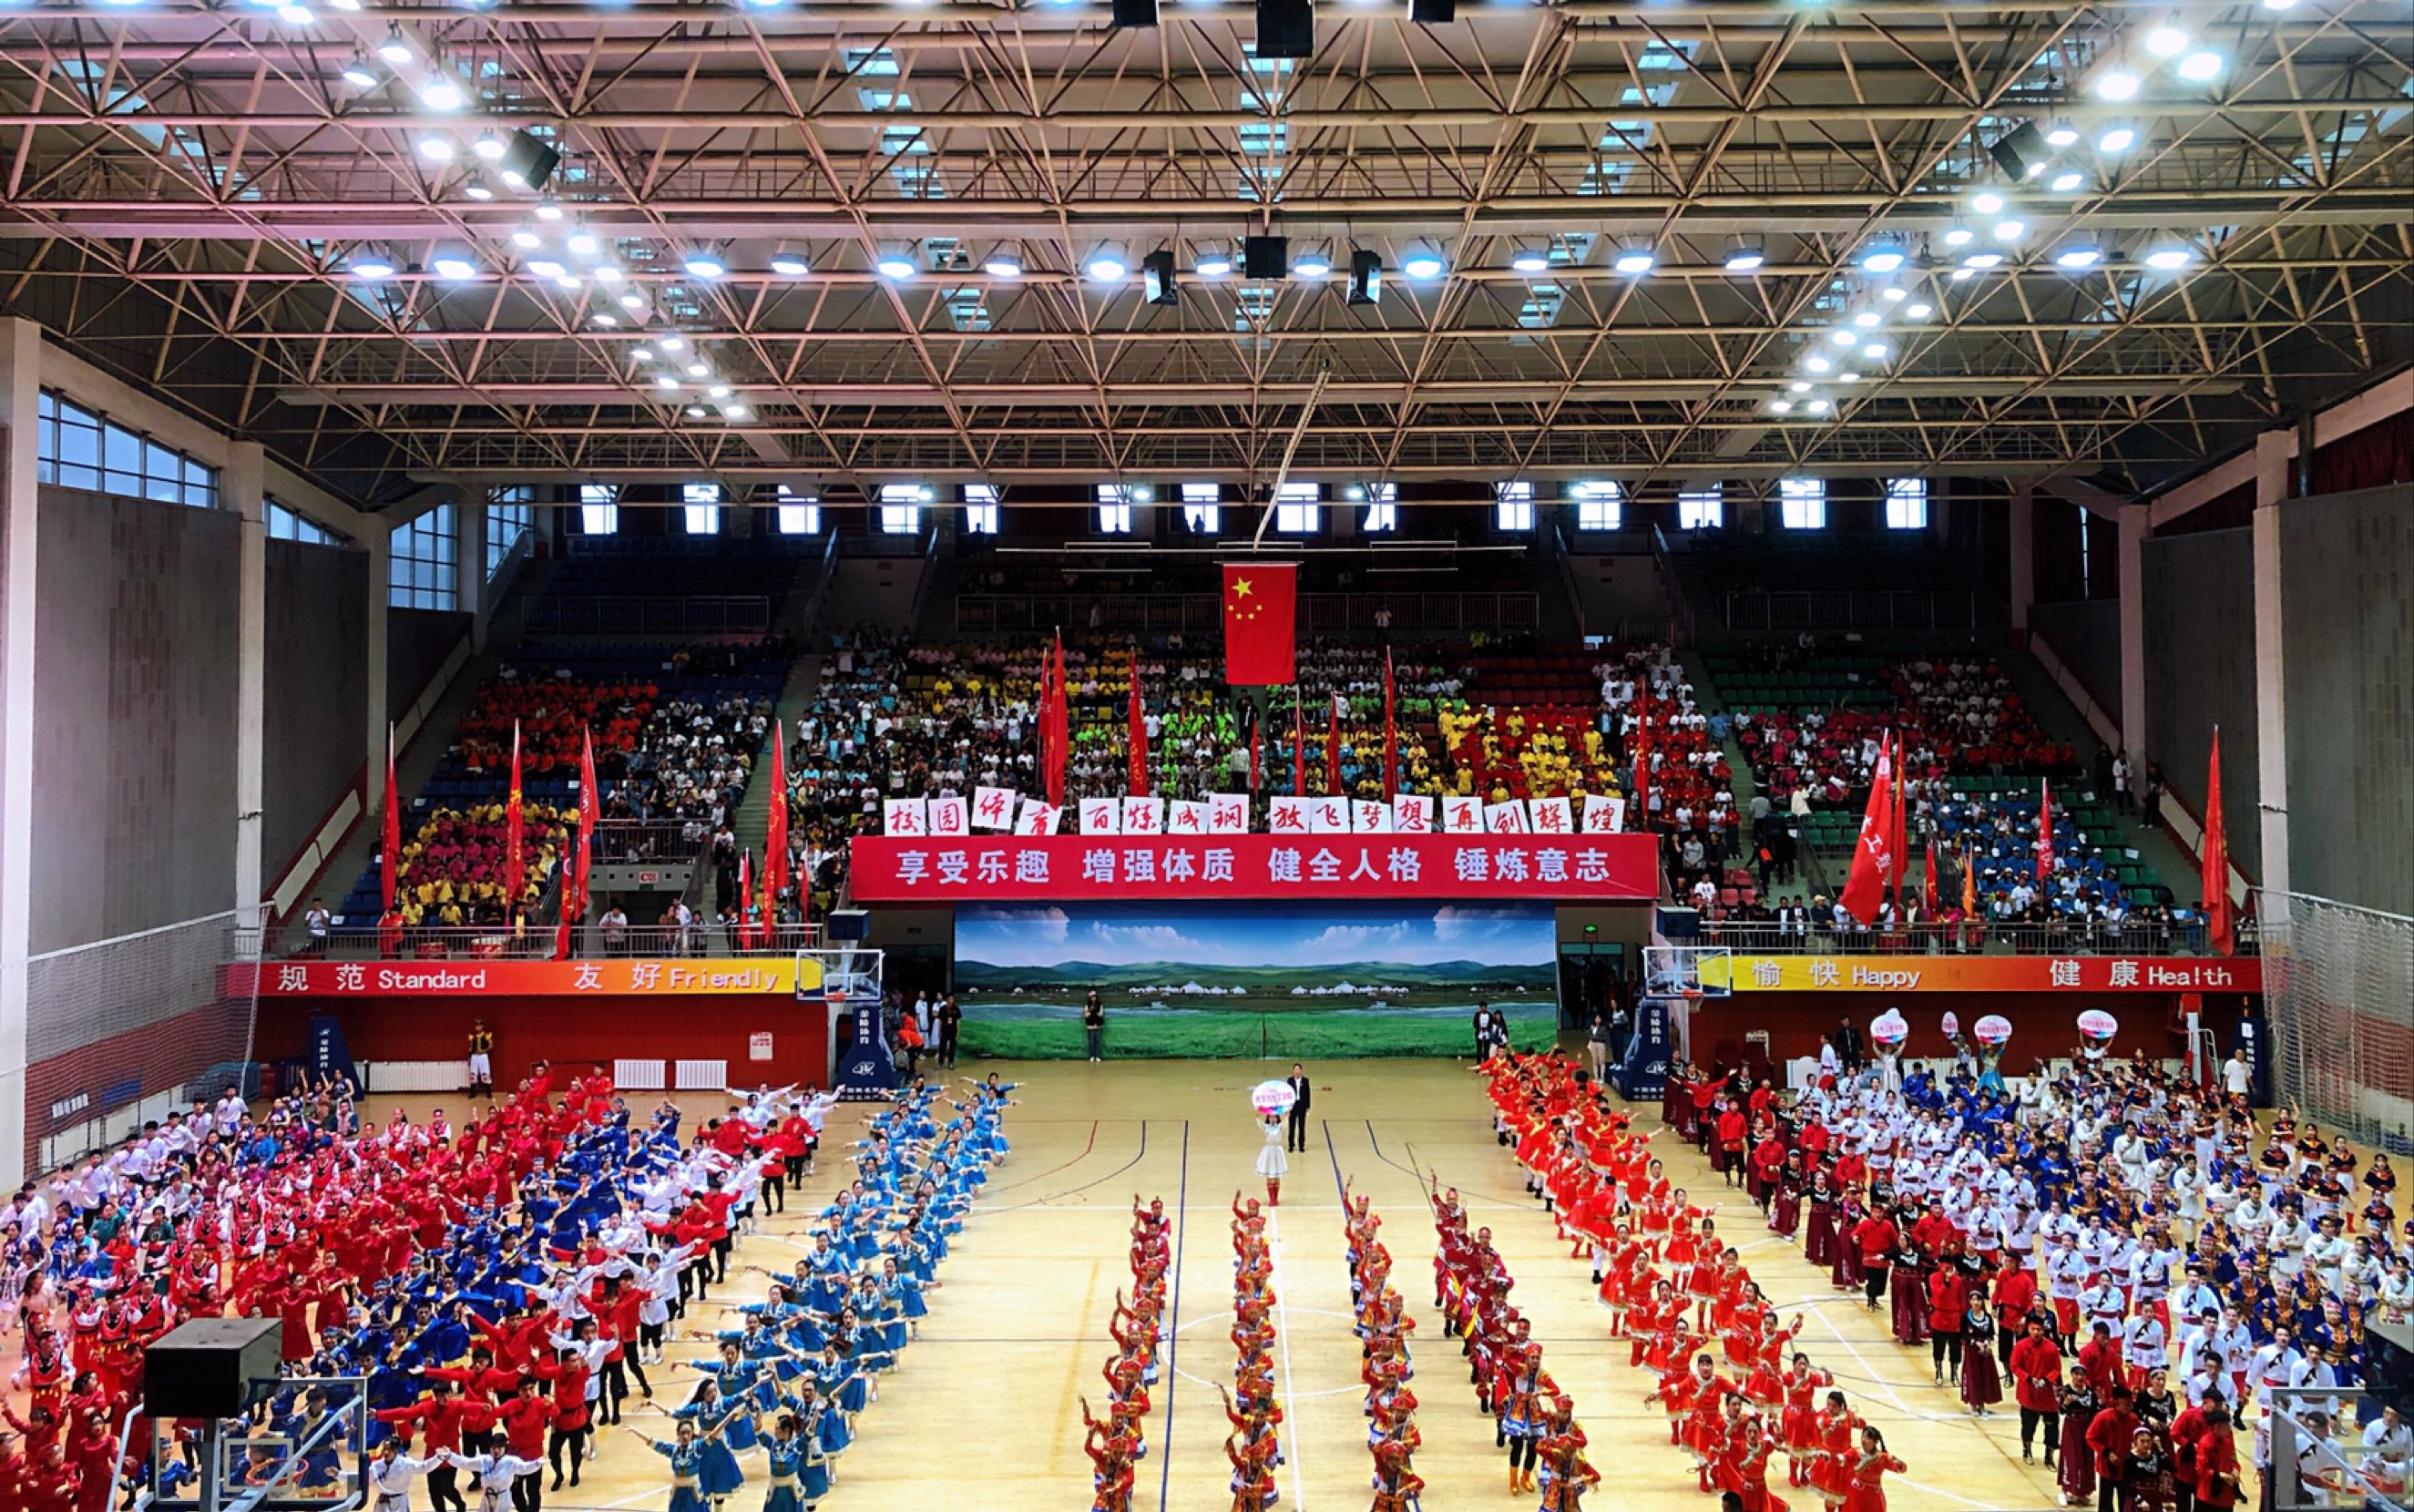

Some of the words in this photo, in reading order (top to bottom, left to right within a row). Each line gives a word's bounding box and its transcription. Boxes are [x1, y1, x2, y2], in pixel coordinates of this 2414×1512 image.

[1273, 799, 1432, 831] 放飞梦想
[895, 849, 1049, 884] 享受乐趣
[1082, 847, 1234, 883] 增强体质
[1267, 847, 1422, 883] 健全人格
[1454, 847, 1610, 883] 锤炼意志
[278, 964, 365, 991] 规范
[378, 968, 486, 989] Standard
[574, 963, 661, 990] 友好
[670, 968, 779, 991] Friendly
[1752, 960, 1840, 986] 愉快
[1852, 965, 1921, 988] Happy
[2050, 959, 2139, 987] 健康
[2148, 965, 2233, 986] Health
